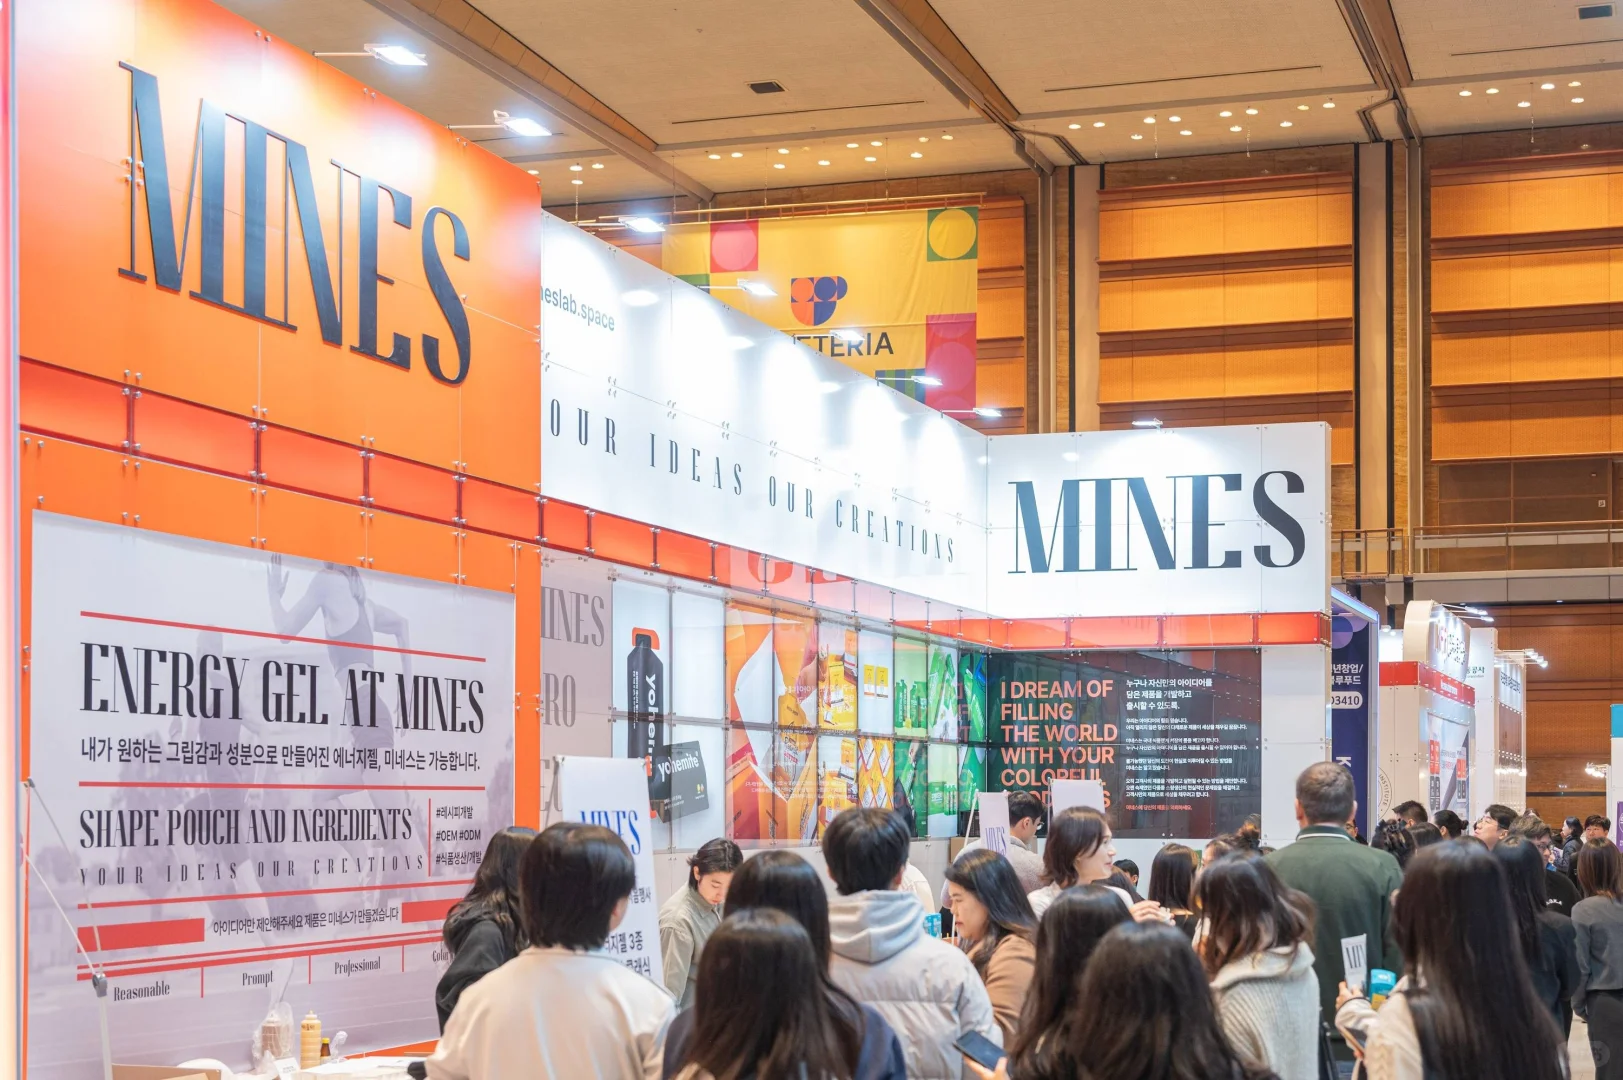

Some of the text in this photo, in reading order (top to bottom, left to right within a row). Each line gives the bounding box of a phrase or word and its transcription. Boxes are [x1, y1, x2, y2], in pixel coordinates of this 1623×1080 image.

[118, 59, 471, 387] MINES
[797, 331, 894, 357] TERIA
[649, 432, 742, 496] IDEAS
[769, 475, 813, 519] OUR
[836, 499, 953, 563] CREATIONS
[1007, 470, 1306, 574] MINES
[1331, 664, 1364, 674] 년창업/
[79, 642, 485, 734] ENERGY GEL AT MINES
[1001, 679, 1114, 699] I DREAM OF
[1126, 678, 1213, 688] 누구나 자신만의 아이디어를
[1331, 675, 1362, 685] 루푸드
[1141, 690, 1162, 699] 제품을
[1163, 690, 1192, 699] 개발하고
[1001, 702, 1073, 721] FILLING
[1148, 702, 1156, 710] 수
[1000, 723, 1118, 743] THE WORLD
[81, 737, 480, 772] 내가 원하는 그립감과 성분으로 만들어진 에너지젤, 미네스는 가능합니다.
[1000, 746, 1115, 764] WITH YOUR
[435, 806, 473, 819] #레시피개발
[79, 807, 412, 849] SHAPE POUCH AND INGREDIENTS
[436, 829, 481, 841] #OEM #ODM
[80, 854, 424, 887] YOUR IDEAS OUR CREATIONS
[213, 918, 255, 936] 아이디어만
[256, 914, 304, 933] 제안해주세요
[304, 911, 327, 928] 제품은
[328, 909, 357, 926] 미네스가
[113, 980, 170, 1001] Reasonable
[242, 970, 274, 988] Prompt
[334, 956, 381, 977] Professional
